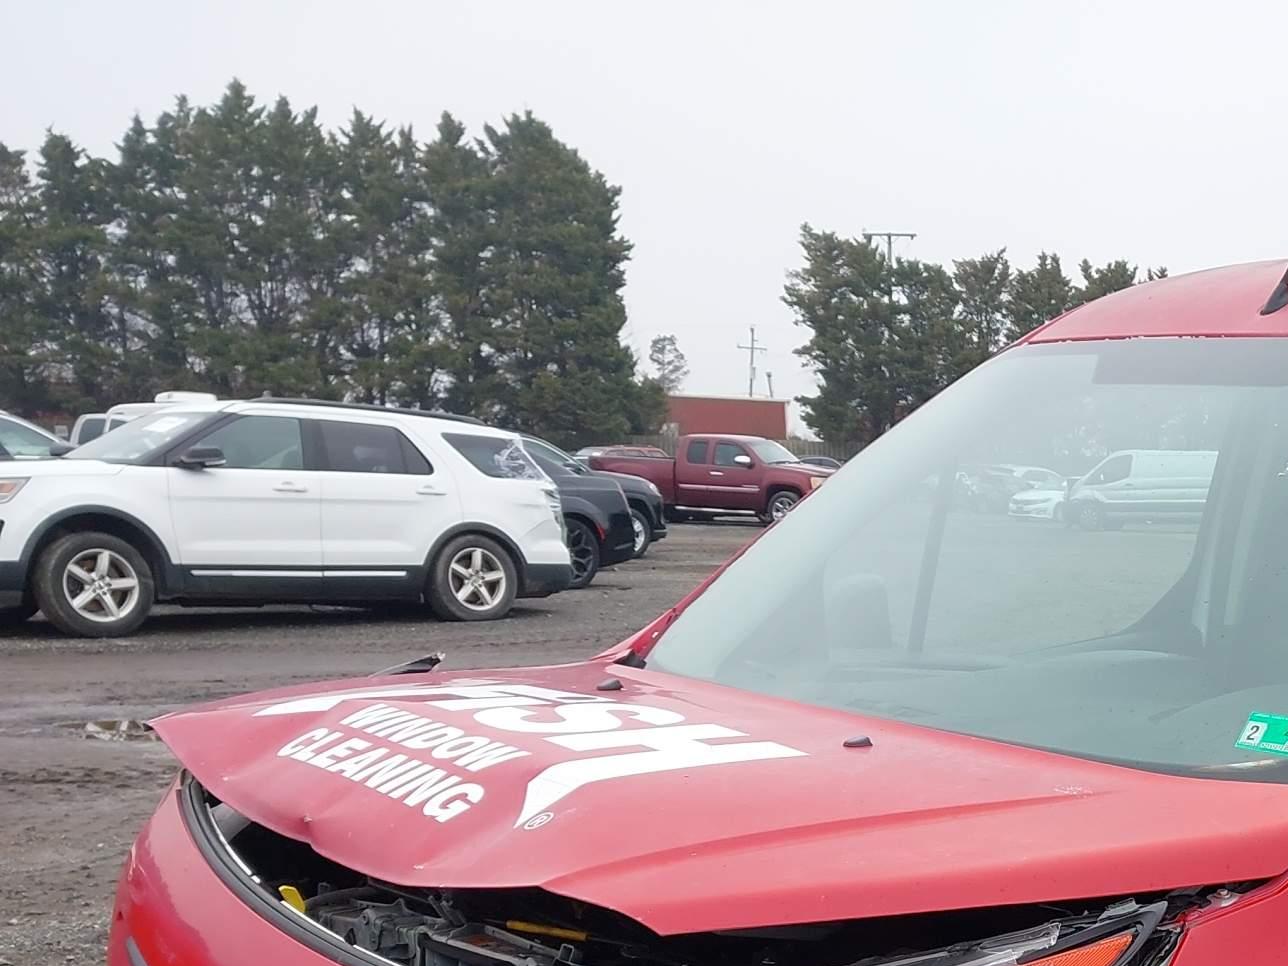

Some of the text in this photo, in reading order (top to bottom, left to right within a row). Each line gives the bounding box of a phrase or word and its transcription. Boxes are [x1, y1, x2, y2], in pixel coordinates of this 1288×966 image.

[339, 703, 531, 772] WINDOW
[1246, 725, 1260, 741] 2
[277, 728, 485, 823] CLEANING
